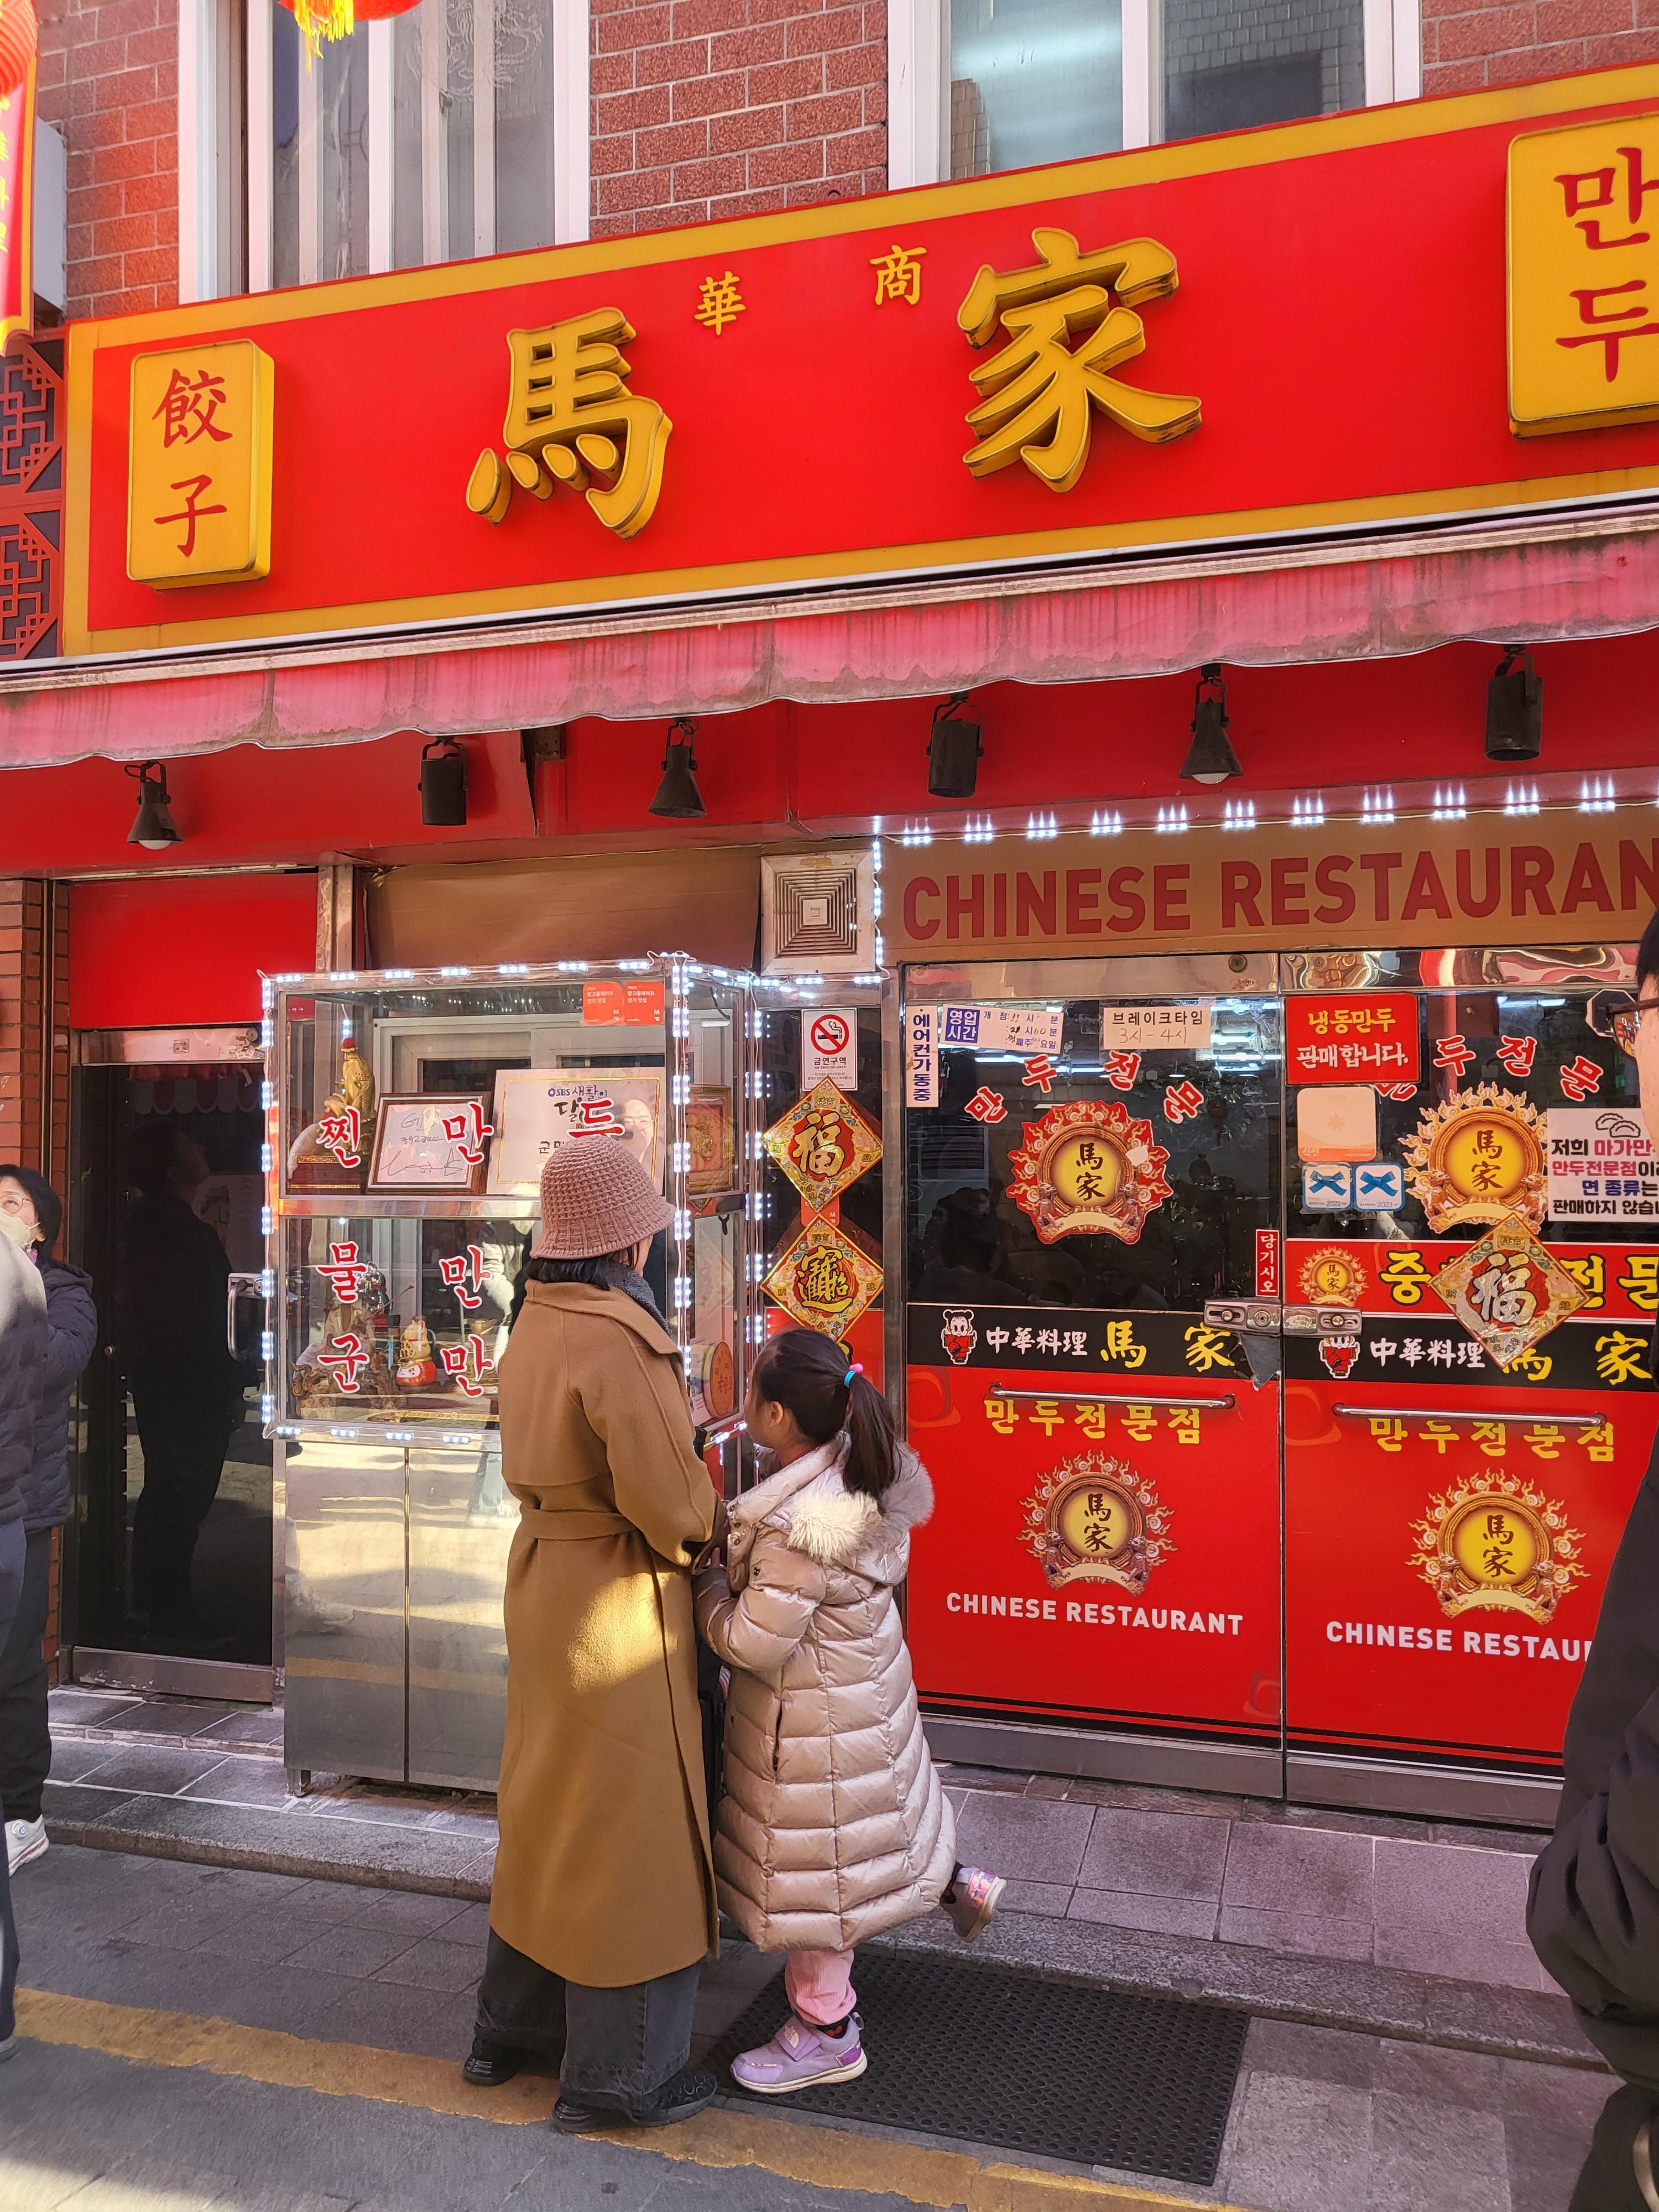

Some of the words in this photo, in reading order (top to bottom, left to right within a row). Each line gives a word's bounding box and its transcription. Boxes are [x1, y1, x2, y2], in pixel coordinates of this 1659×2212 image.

[1553, 147, 1659, 383] 만두
[466, 306, 672, 540] 馬
[694, 270, 747, 335] 華
[870, 245, 927, 306] 商
[957, 227, 1202, 493] 家
[152, 368, 233, 557] 餃子
[903, 863, 1190, 941] CHINESE
[1221, 836, 1659, 928] RESTAURAN
[947, 1025, 977, 1041] 시간
[950, 1010, 977, 1026] 영업
[1112, 1010, 1203, 1026] 브레이크타임
[1308, 1008, 1396, 1035] 냉동만두
[813, 1057, 846, 1066] 금연구역
[913, 1014, 932, 1101] 에어컨가동중
[1296, 1042, 1409, 1069] 판매합니다.
[792, 1112, 846, 1177] 福
[1472, 1130, 1503, 1192] 馬家
[1552, 1139, 1588, 1156] 저희
[1594, 1139, 1656, 1156] 마가만
[1075, 1142, 1106, 1202] 馬家
[1552, 1161, 1659, 1177] 만두전문점이
[1553, 1199, 1616, 1214] 판매하지
[1622, 1200, 1659, 1215] 않습
[1582, 1180, 1599, 1196] 면
[1605, 1180, 1658, 1197] 종류는
[1260, 1234, 1277, 1293] 당기시오
[1326, 1264, 1341, 1291] 馬家
[1470, 1252, 1538, 1327] 福
[986, 1326, 1088, 1357] 中華料理
[1370, 1337, 1486, 1369] 中華料理
[984, 1399, 1201, 1444] 만두전문점
[1084, 1493, 1113, 1553] 馬家
[1483, 1515, 1516, 1578] 馬家
[946, 1593, 1057, 1620] CHINESE
[1066, 1601, 1243, 1635] RESTAURANT
[1326, 1621, 1453, 1651] CHINESE
